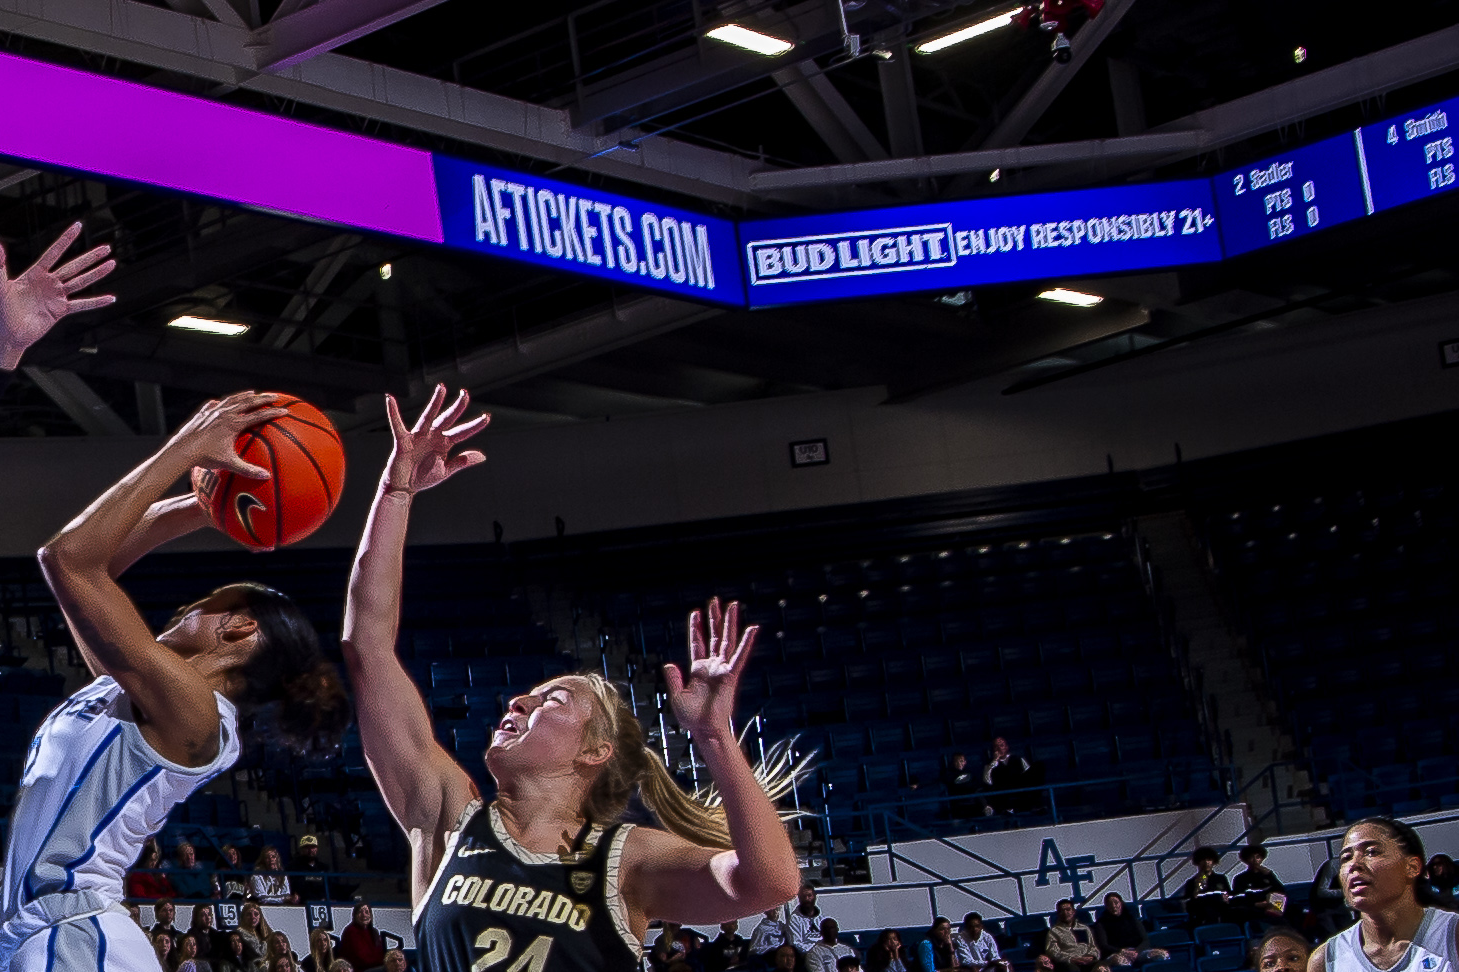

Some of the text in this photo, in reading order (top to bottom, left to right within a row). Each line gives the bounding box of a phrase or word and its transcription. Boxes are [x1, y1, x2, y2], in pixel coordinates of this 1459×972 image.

[1424, 137, 1455, 164] PTS
[1233, 174, 1246, 196] 2
[1428, 163, 1456, 189] FLS
[1264, 188, 1293, 215] PTS
[472, 174, 715, 290] AFTICKETS.COM
[955, 208, 1215, 257] ENJOY RESPONSIBLY 21+
[1268, 214, 1295, 240] FLS
[755, 231, 947, 277] BUD LIGHT
[441, 875, 591, 932] COLORADO
